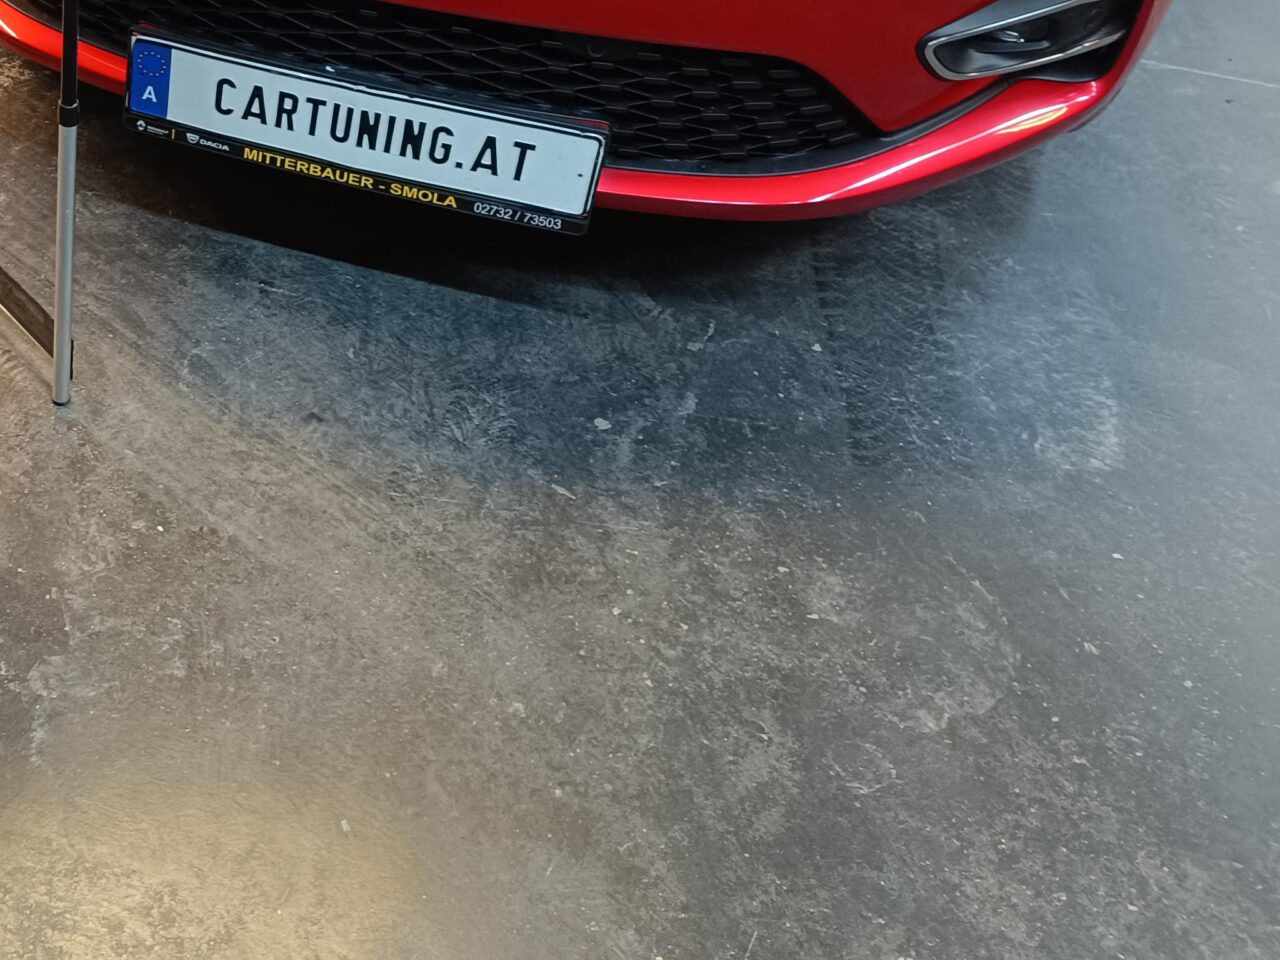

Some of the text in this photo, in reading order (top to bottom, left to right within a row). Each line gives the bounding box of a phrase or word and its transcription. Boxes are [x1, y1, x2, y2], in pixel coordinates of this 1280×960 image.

[141, 84, 158, 104] A
[213, 77, 537, 182] CARTUNING.AT
[199, 138, 230, 152] DACIA
[243, 146, 375, 190] MITTERBAUER
[389, 181, 458, 209] SMOLA
[473, 201, 513, 220] 02732
[523, 212, 562, 230] 73503
